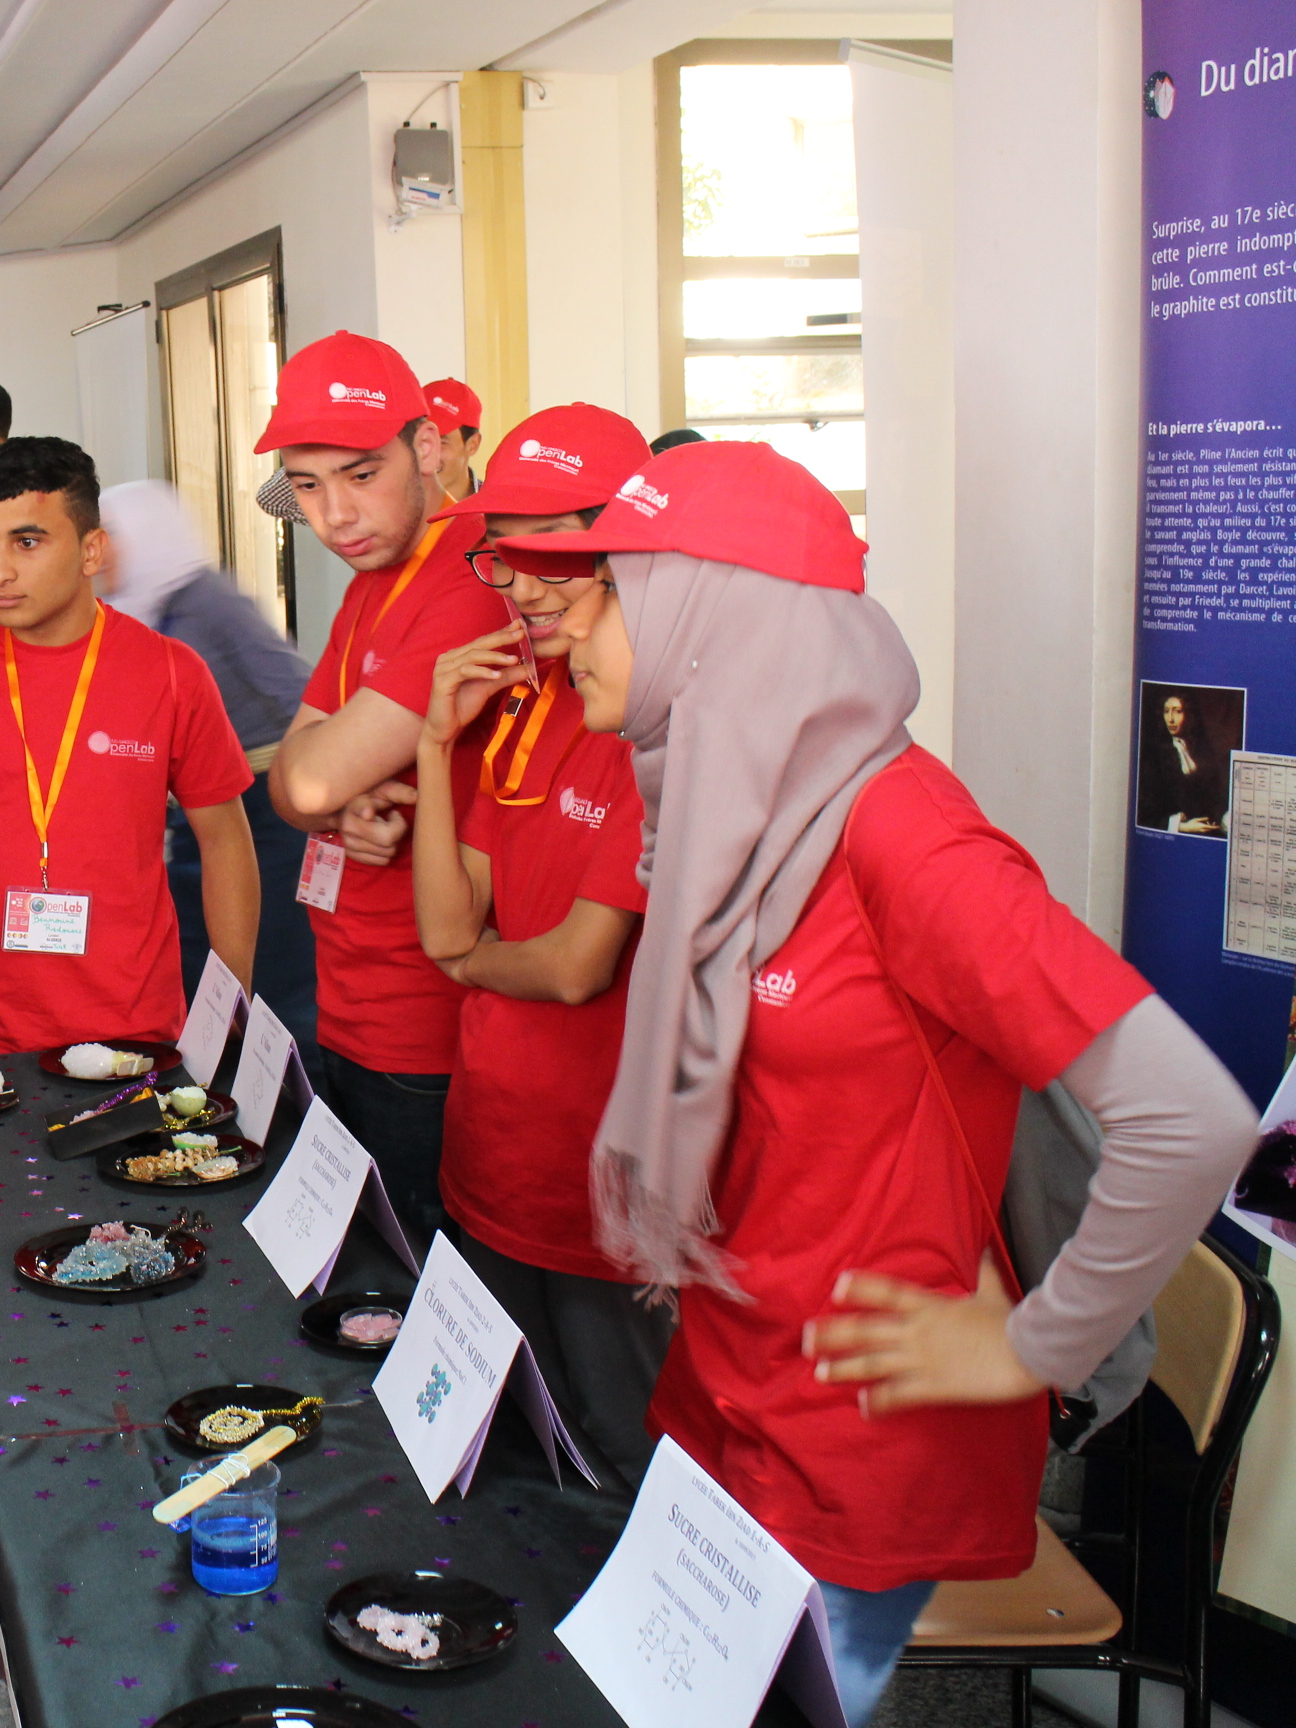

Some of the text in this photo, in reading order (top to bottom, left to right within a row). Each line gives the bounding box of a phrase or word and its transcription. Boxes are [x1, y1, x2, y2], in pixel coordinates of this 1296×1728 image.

[1201, 60, 1236, 96] Du
[1152, 201, 1296, 239] Surprise, au 17e sièc
[1152, 248, 1179, 264] cette
[1187, 242, 1228, 263] pierre
[1152, 272, 1183, 291] brûle.
[1190, 264, 1257, 286] Comment
[1151, 301, 1159, 317] le
[1163, 296, 1215, 320] graphite
[1220, 293, 1240, 309] est
[1149, 423, 1156, 435] Et
[1159, 422, 1167, 435] la
[1170, 421, 1204, 437] pierre
[1159, 447, 1283, 461] 1er siècle, Pline l'Ancien écrit
[1147, 465, 1173, 474] diamant
[1177, 465, 1188, 473] est
[1193, 465, 1208, 473] non
[1213, 462, 1258, 472] seulement
[1147, 474, 1282, 488] feu, mais en plus les feux les plus
[1146, 488, 1294, 501] parviennent même pas le chauffer
[1152, 503, 1283, 514] transmet la chaleur). Aussi, c'est
[1145, 516, 1286, 528] toute attente, qu'au milieu du 17e
[1155, 530, 1288, 542] savant anglais Boyle découvre,
[1145, 543, 1258, 555] comprendre, que le diamant
[1145, 556, 1271, 569] sous l'influence d'une grande
[1180, 570, 1193, 579] 19e
[1202, 570, 1228, 581] siècle,
[1238, 570, 1249, 580] les
[1171, 584, 1217, 593] notamment
[1222, 585, 1235, 595] par
[1240, 584, 1268, 596] Darcet,
[1151, 595, 1290, 610] ensuite par Friedel, se multiplient
[1154, 608, 1283, 623] comprendre le mécanisme de
[1143, 620, 1196, 632] transformation.
[424, 1288, 496, 1389] CLORURE DE SODIUM
[668, 1503, 701, 1547] SUCRE
[699, 1537, 762, 1609] CRISTALLISE
[676, 1548, 731, 1613] (SACCHAROSE)
